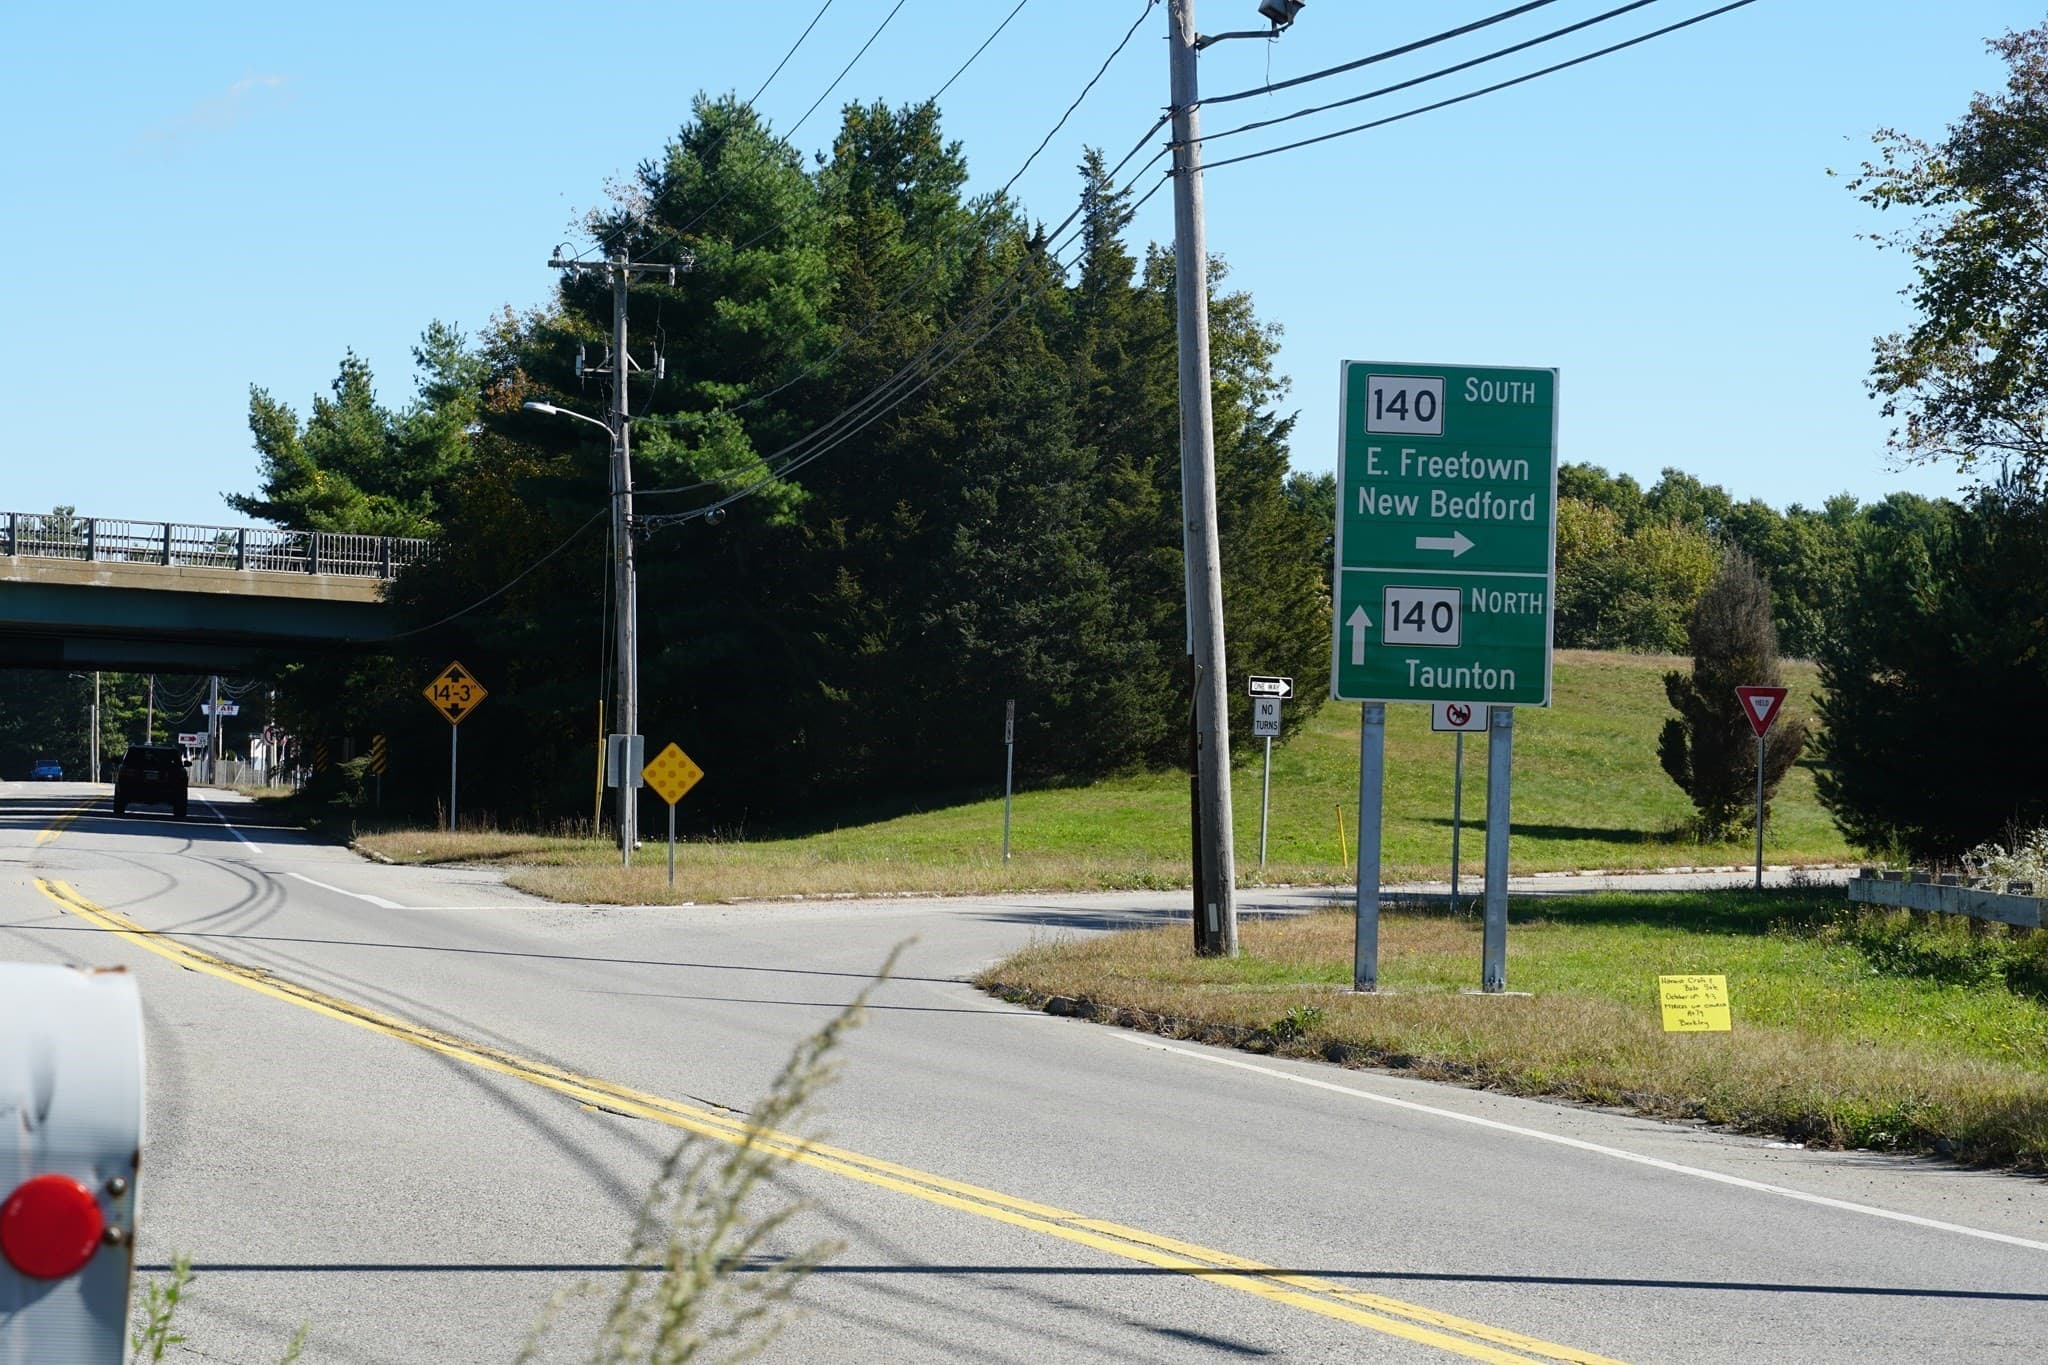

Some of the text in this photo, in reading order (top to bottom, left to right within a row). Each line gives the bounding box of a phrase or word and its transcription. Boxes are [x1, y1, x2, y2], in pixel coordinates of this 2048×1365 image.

[1374, 389, 1437, 422] 140
[1464, 376, 1536, 404] SOUTH
[1367, 447, 1529, 481] E. Freetown
[1358, 486, 1535, 521] New Bedford
[1391, 600, 1453, 633] 140
[1471, 587, 1543, 615] NORTH
[1405, 659, 1515, 690] Taunton
[1256, 720, 1278, 730] TURNS
[1261, 704, 1273, 715] NO
